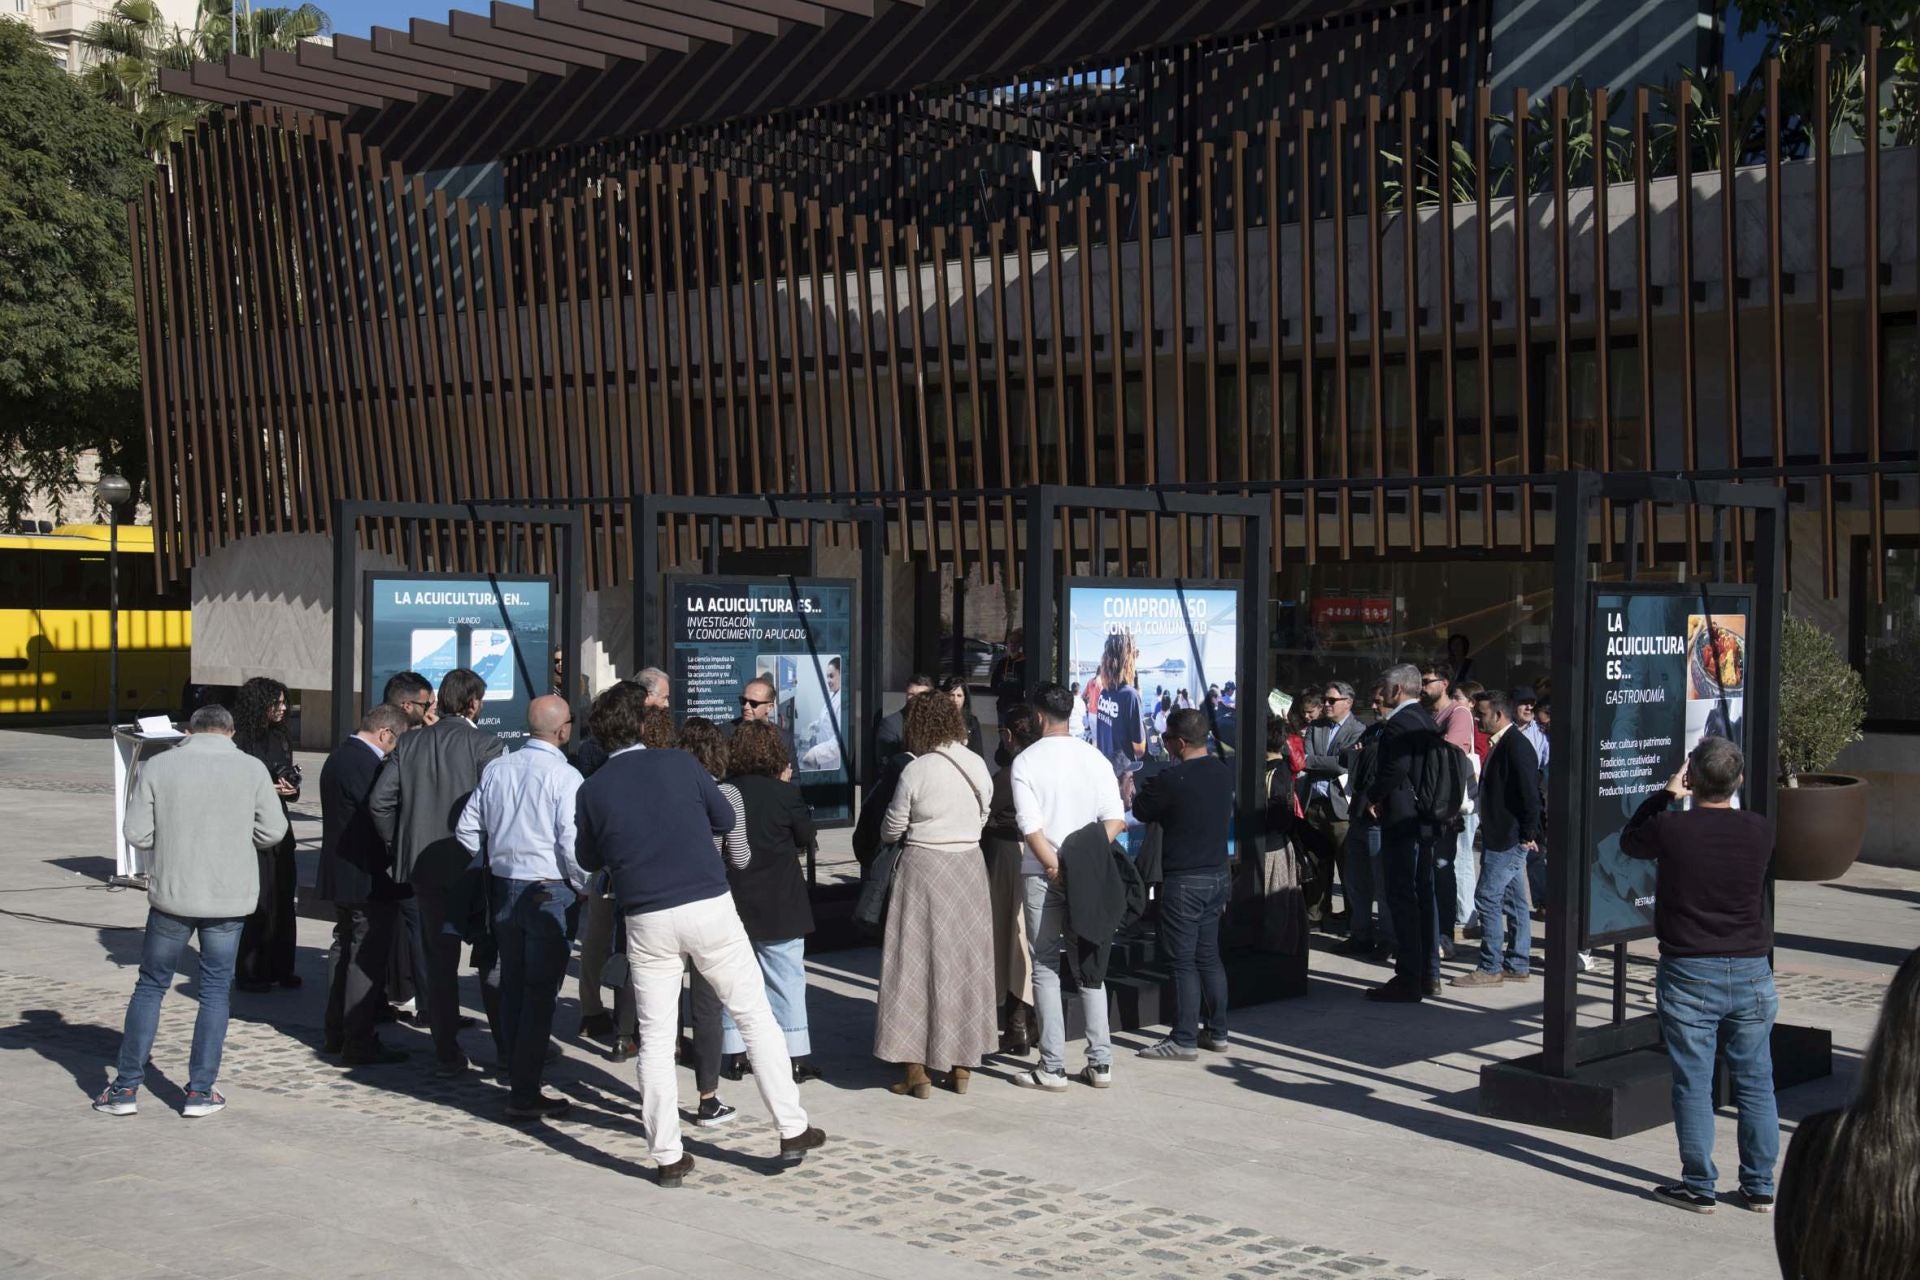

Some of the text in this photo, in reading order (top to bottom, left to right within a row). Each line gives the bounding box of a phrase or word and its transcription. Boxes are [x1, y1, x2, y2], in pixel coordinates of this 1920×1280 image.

[395, 592, 530, 606] LA ACUICULTURA EN...
[687, 597, 822, 613] LA ACUICULTURA ES...
[1103, 597, 1207, 618] COMPROMSO
[687, 615, 755, 627] INVESTIGACIÓN
[1104, 620, 1126, 635] CON
[1129, 621, 1141, 634] LA
[1607, 613, 1623, 632] LA
[688, 628, 807, 640] Y CONOCIMIENTO APLICADO
[1606, 636, 1685, 656] ACUICULTURA
[1606, 660, 1631, 680] ES...
[1605, 685, 1665, 705] GASTRONOMÍA
[477, 717, 501, 725] MURCIA
[497, 731, 520, 739] FUTURO
[1600, 736, 1671, 750] Sabor, cultura y patrimonio
[1600, 754, 1660, 768] Tradición, creatividad e
[1600, 766, 1652, 780] innovación culinaria
[1599, 785, 1623, 797] Producto
[1624, 784, 1637, 794] local
[1638, 783, 1644, 793] de
[1634, 896, 1656, 907] RESTAUR
